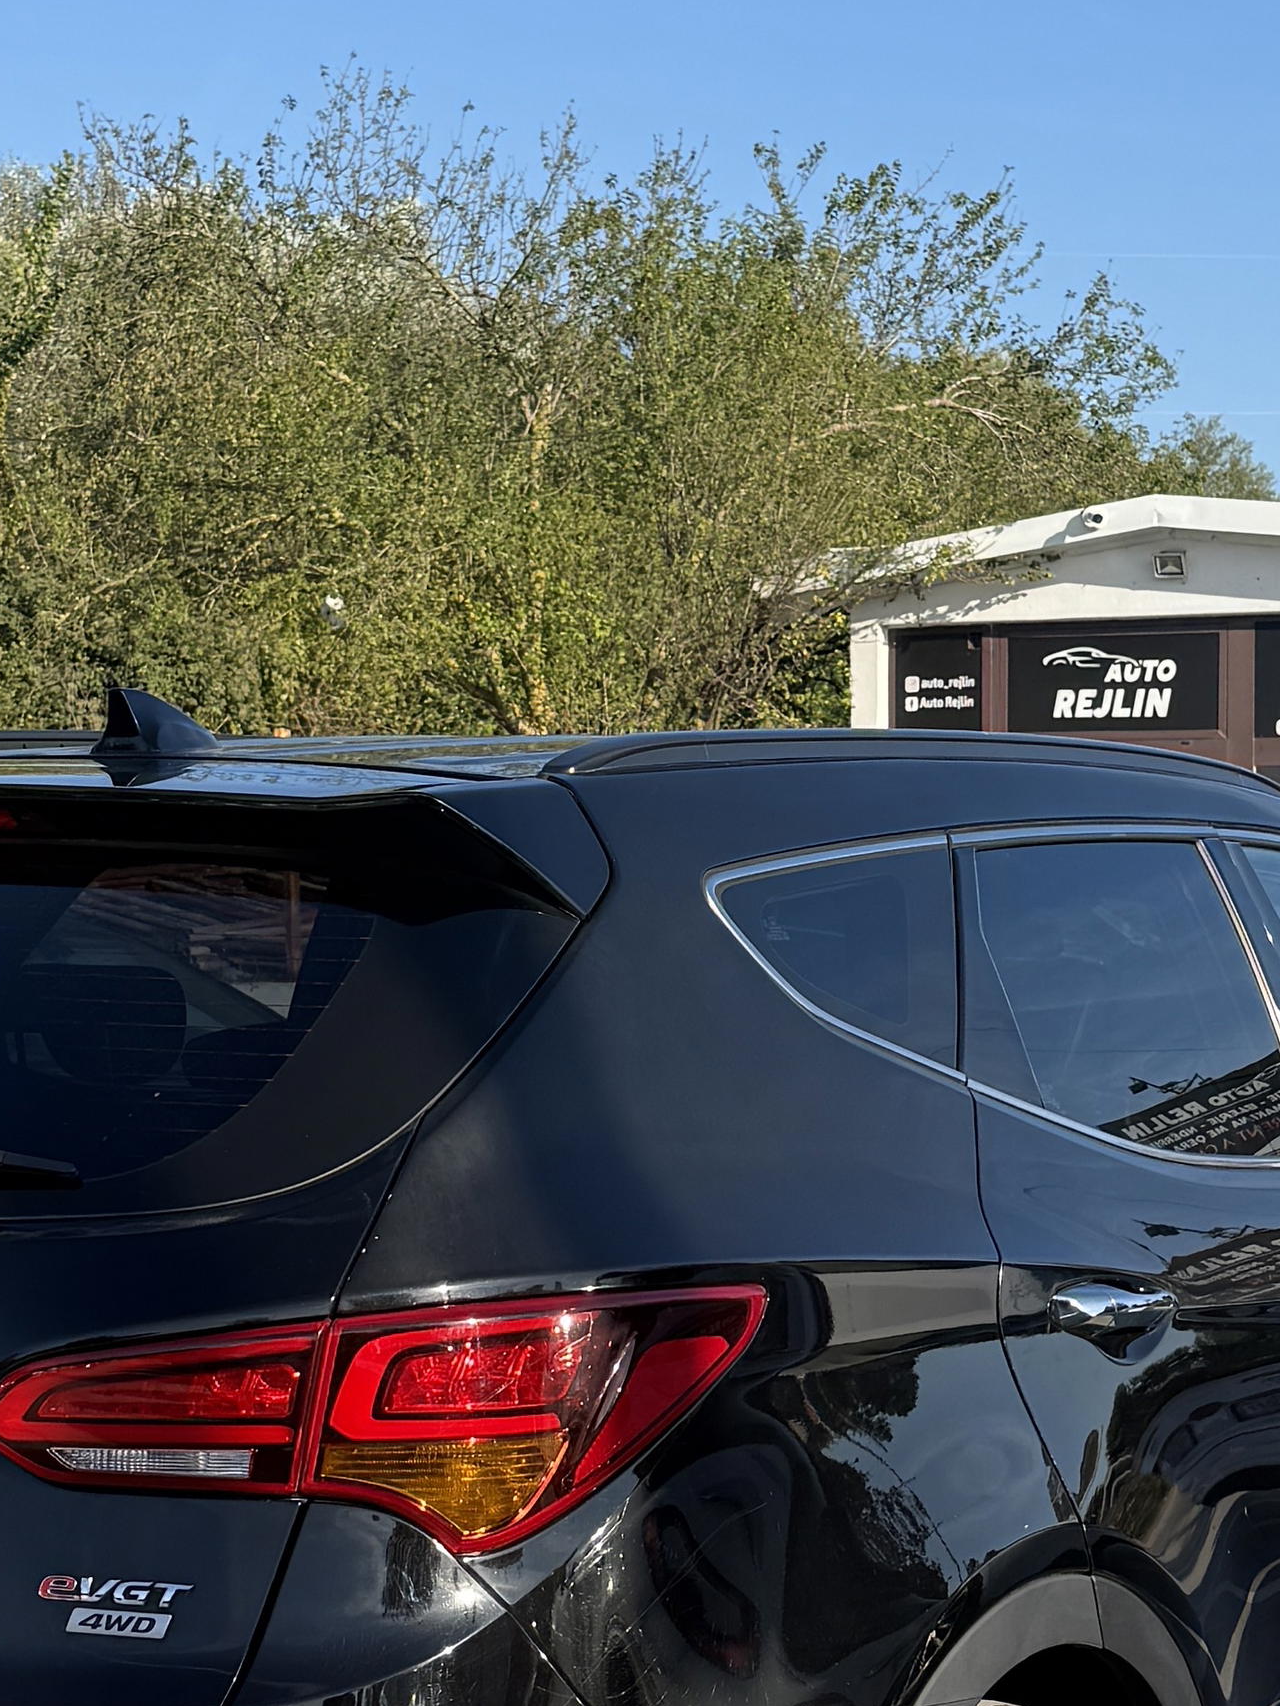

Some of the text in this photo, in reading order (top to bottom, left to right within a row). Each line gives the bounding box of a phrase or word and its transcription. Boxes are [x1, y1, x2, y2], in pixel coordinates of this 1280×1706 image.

[1104, 659, 1177, 683] AUTO
[920, 695, 975, 710] Auto Rejlin
[1053, 688, 1173, 718] REJLIN
[78, 1612, 158, 1634] 4WD
